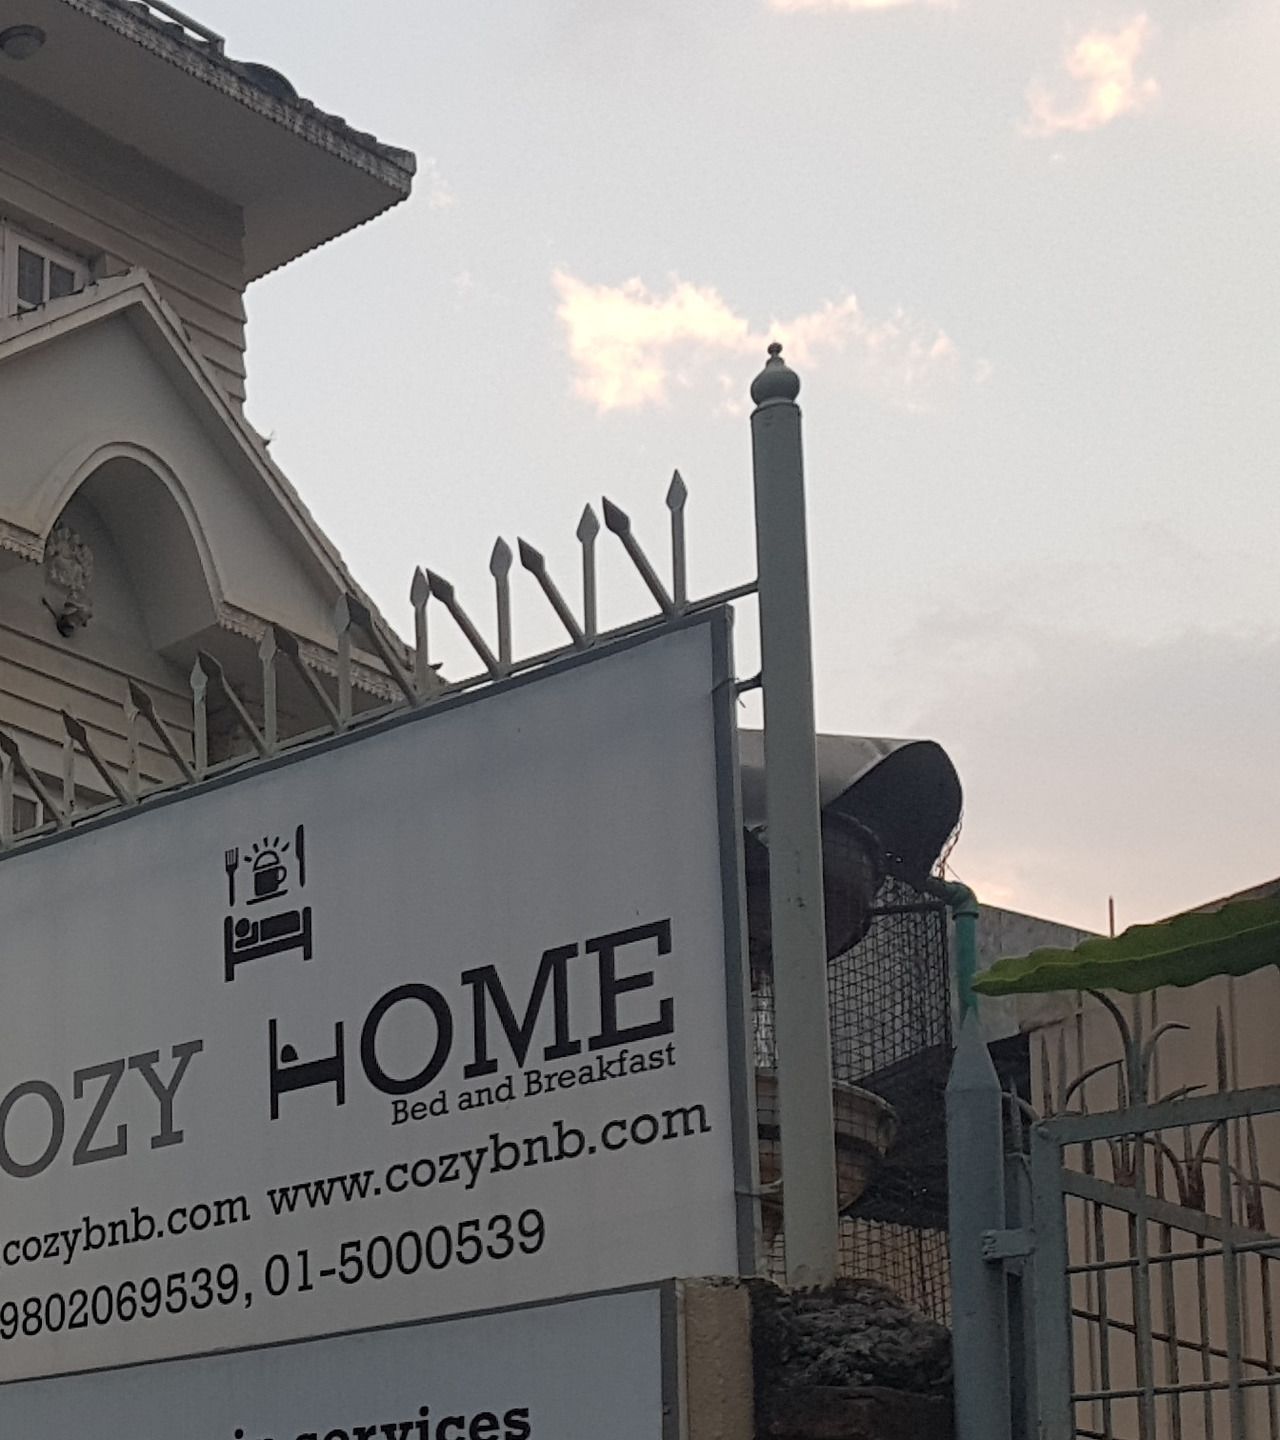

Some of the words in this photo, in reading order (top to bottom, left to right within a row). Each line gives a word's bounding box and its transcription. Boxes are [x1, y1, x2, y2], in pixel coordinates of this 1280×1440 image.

[269, 918, 674, 1121] HOME
[391, 1089, 449, 1125] Bed
[458, 1075, 516, 1111] and
[523, 1042, 676, 1098] Breakfast
[267, 1104, 711, 1216] www.cozybnb.com
[0, 1263, 252, 1340] 9802069539,
[265, 1209, 545, 1297] 01-5000539
